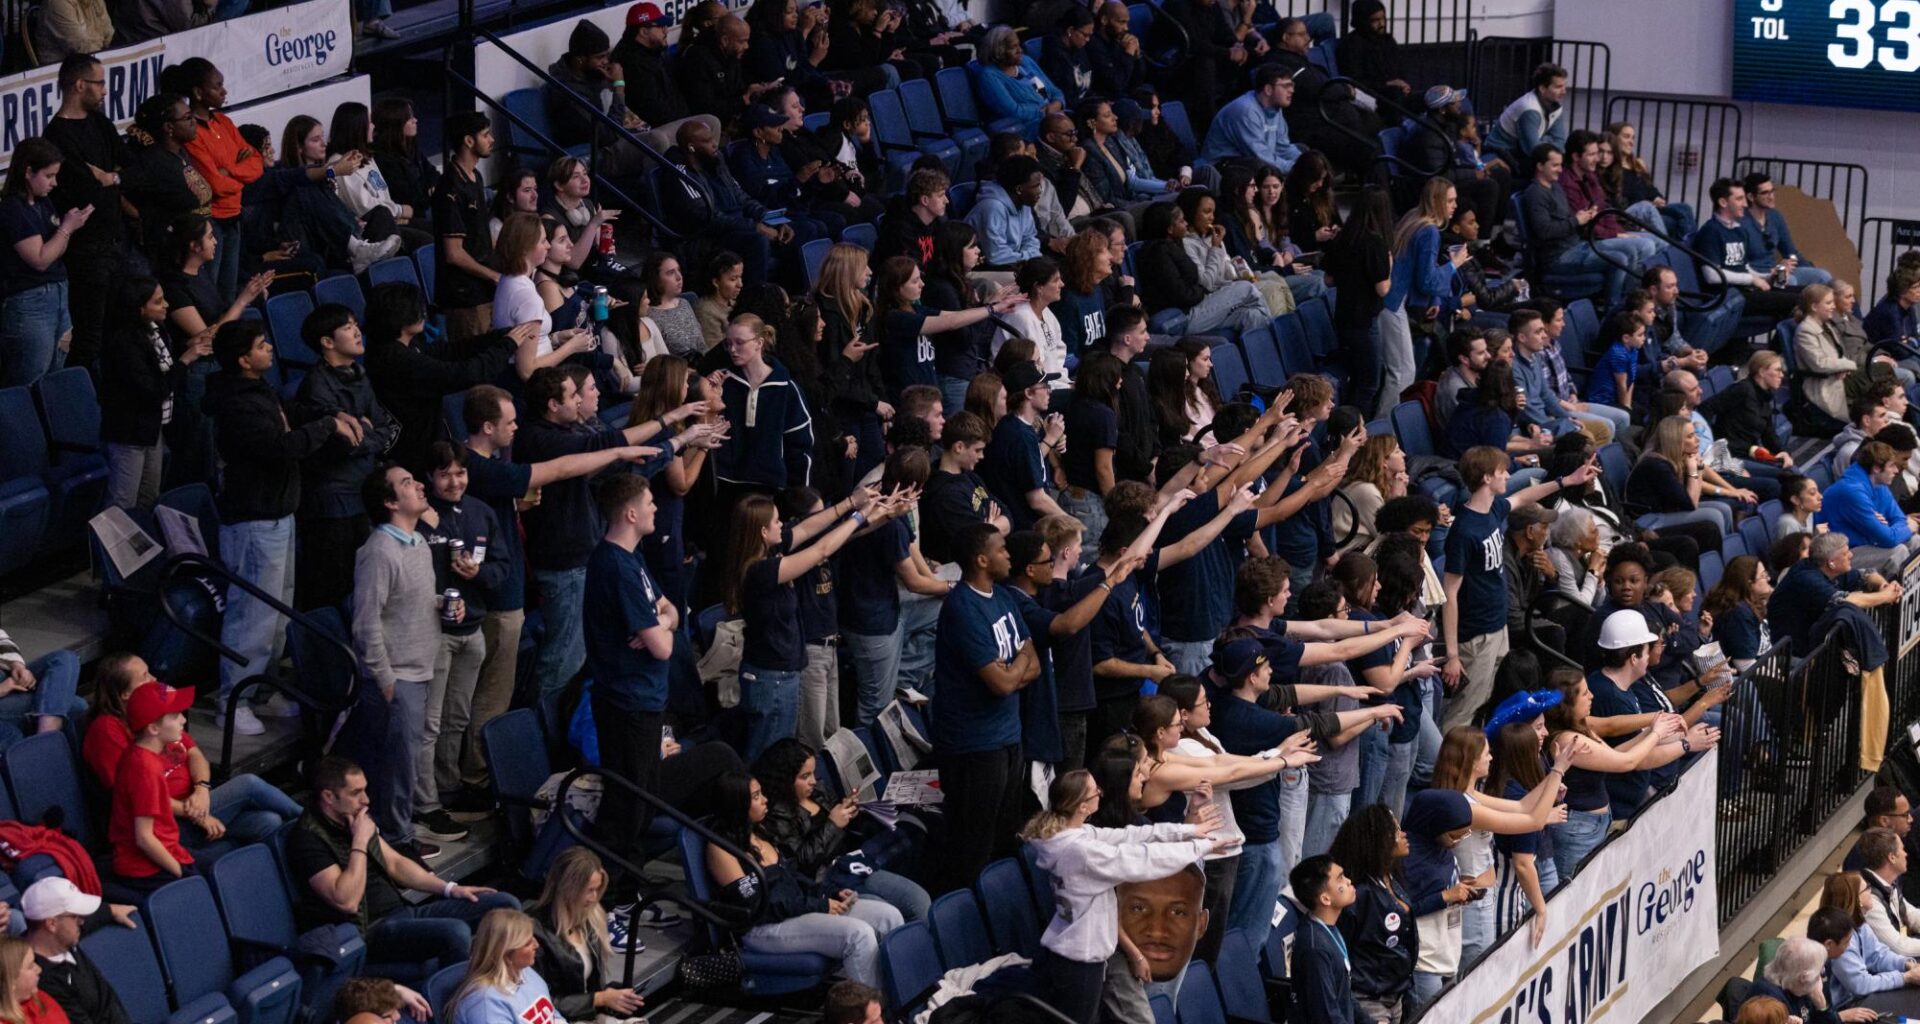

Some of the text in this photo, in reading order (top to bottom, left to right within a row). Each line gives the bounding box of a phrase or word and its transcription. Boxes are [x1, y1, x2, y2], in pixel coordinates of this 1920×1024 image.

[265, 30, 336, 66] George
[1751, 17, 1789, 40] TOL
[1827, 0, 1920, 72] 33
[101, 54, 164, 122] RMY
[1637, 850, 1705, 936] George
[1658, 867, 1672, 885] the
[1565, 887, 1631, 1024] ARMY
